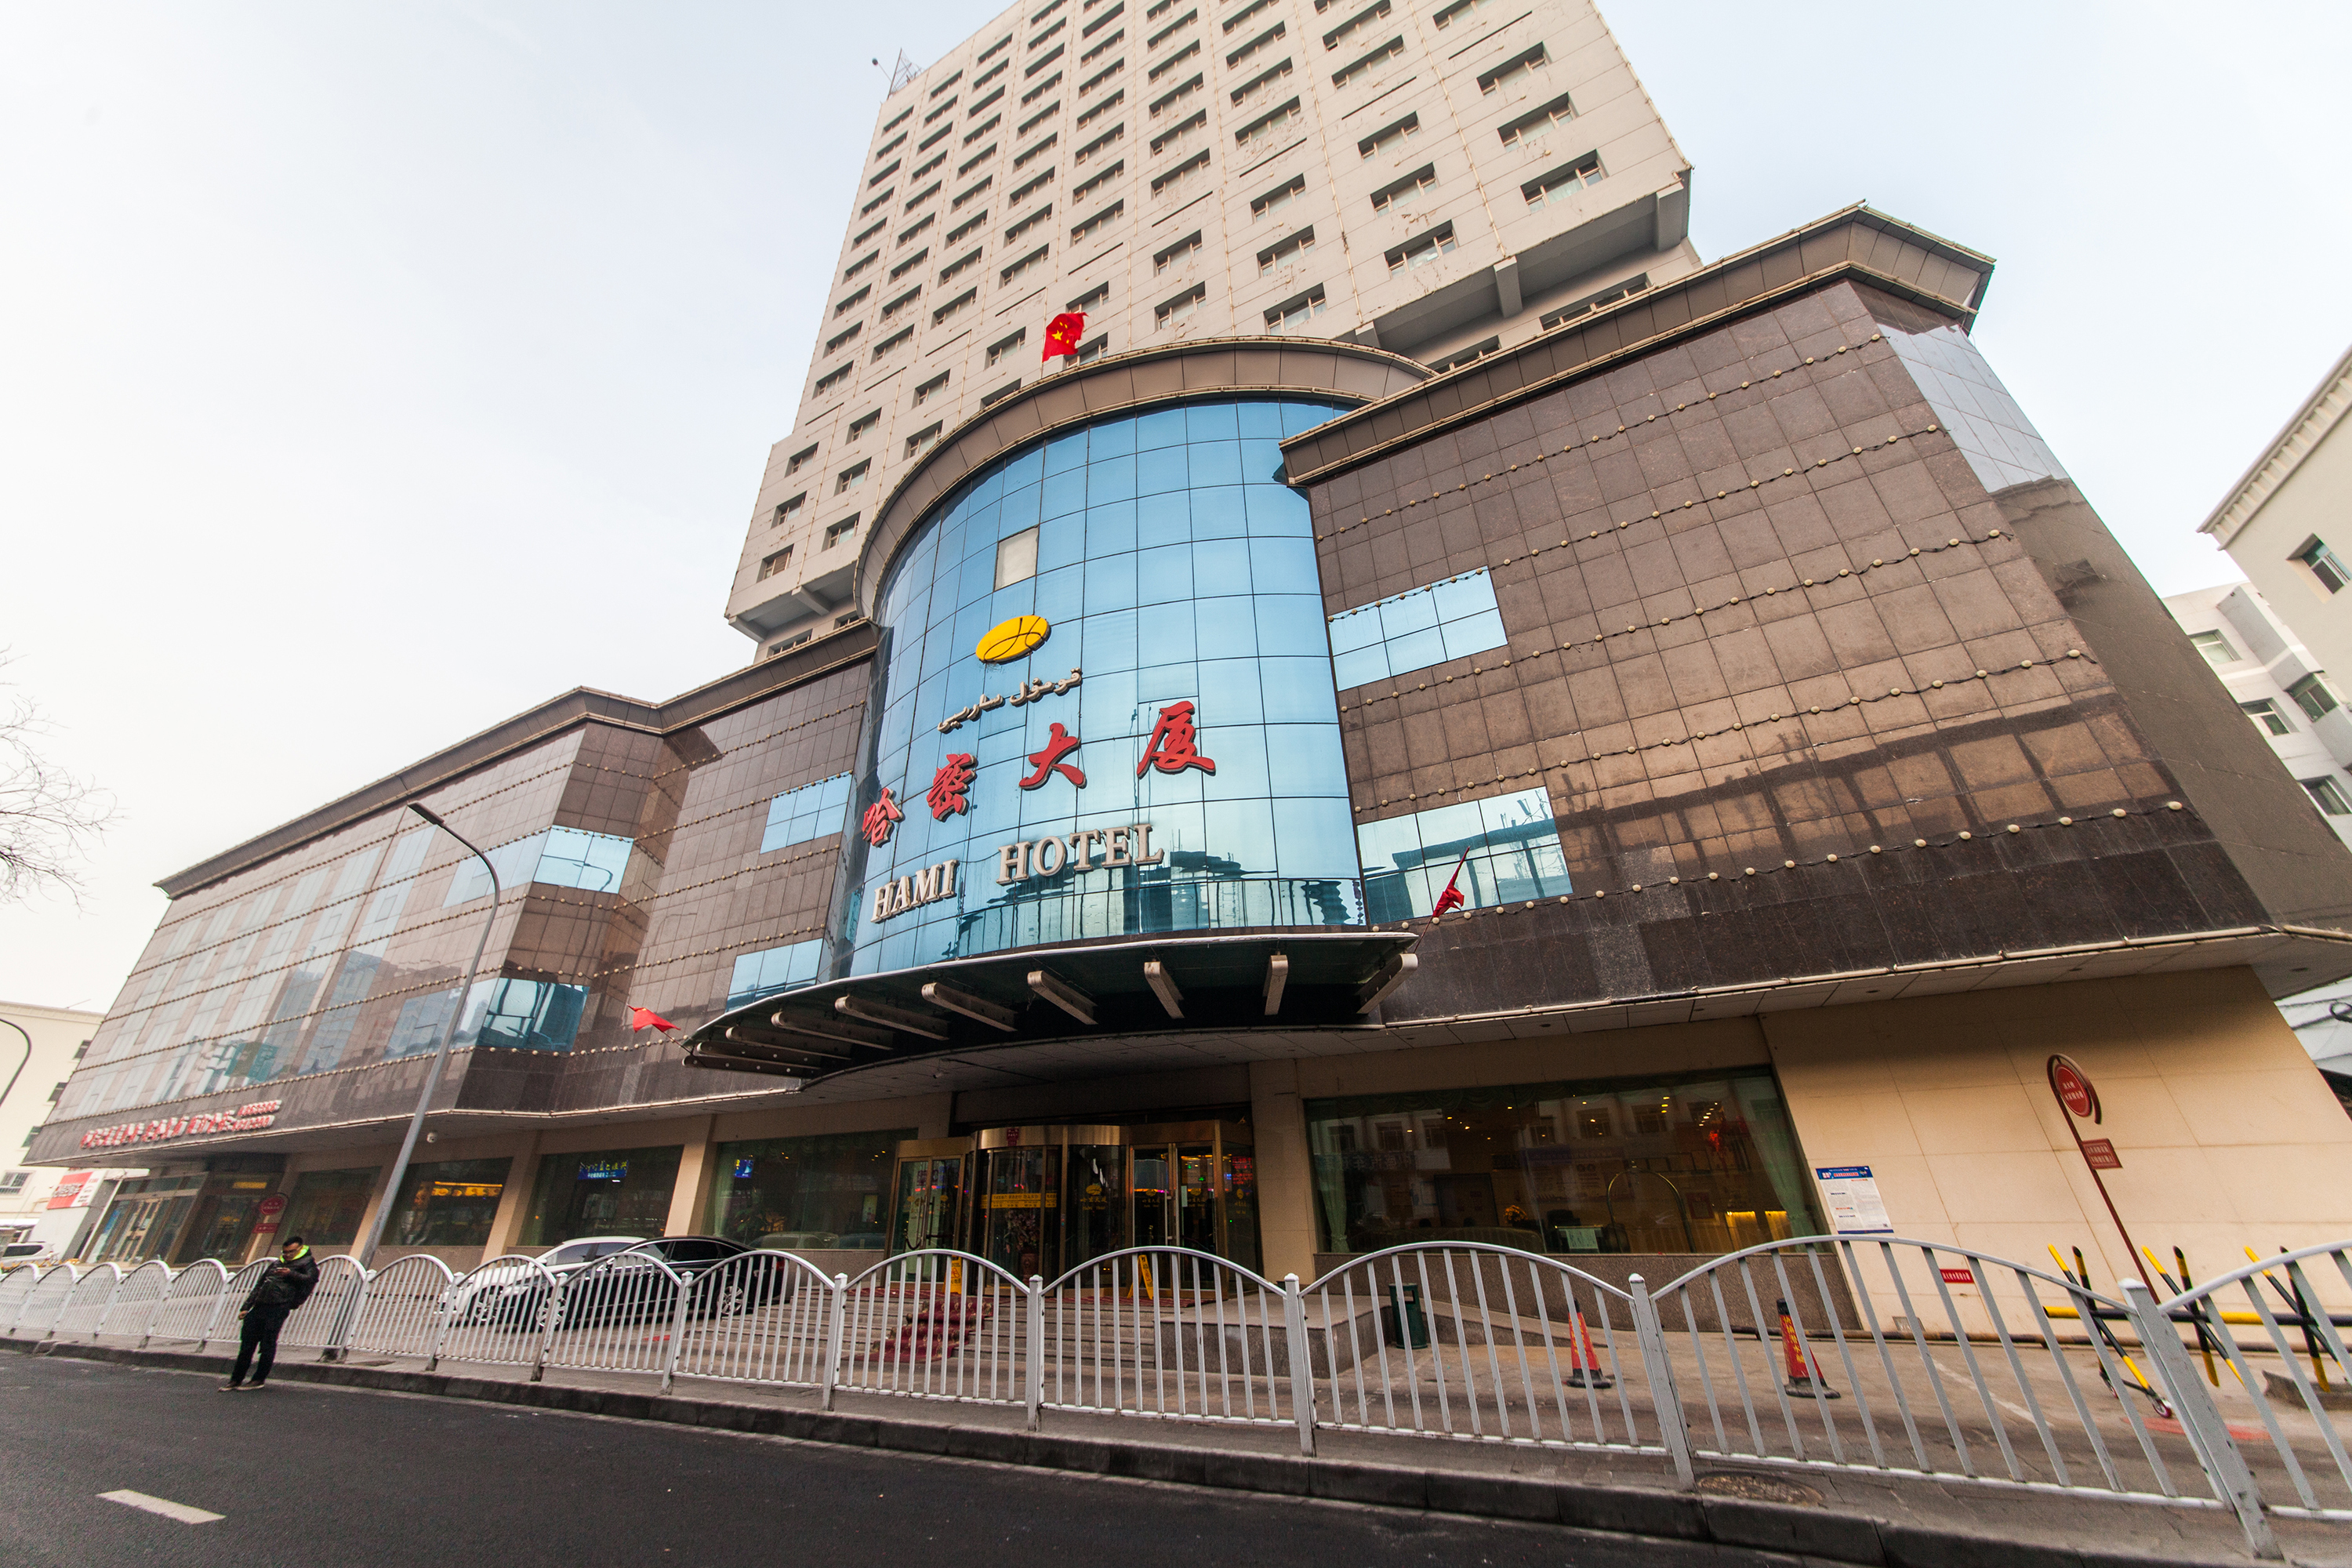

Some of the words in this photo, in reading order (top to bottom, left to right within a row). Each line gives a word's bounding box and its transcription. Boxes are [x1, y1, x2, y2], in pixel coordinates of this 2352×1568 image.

[862, 700, 1216, 848] 哈密大厦
[870, 859, 959, 923] HAMI
[996, 823, 1165, 886] HOTEL
